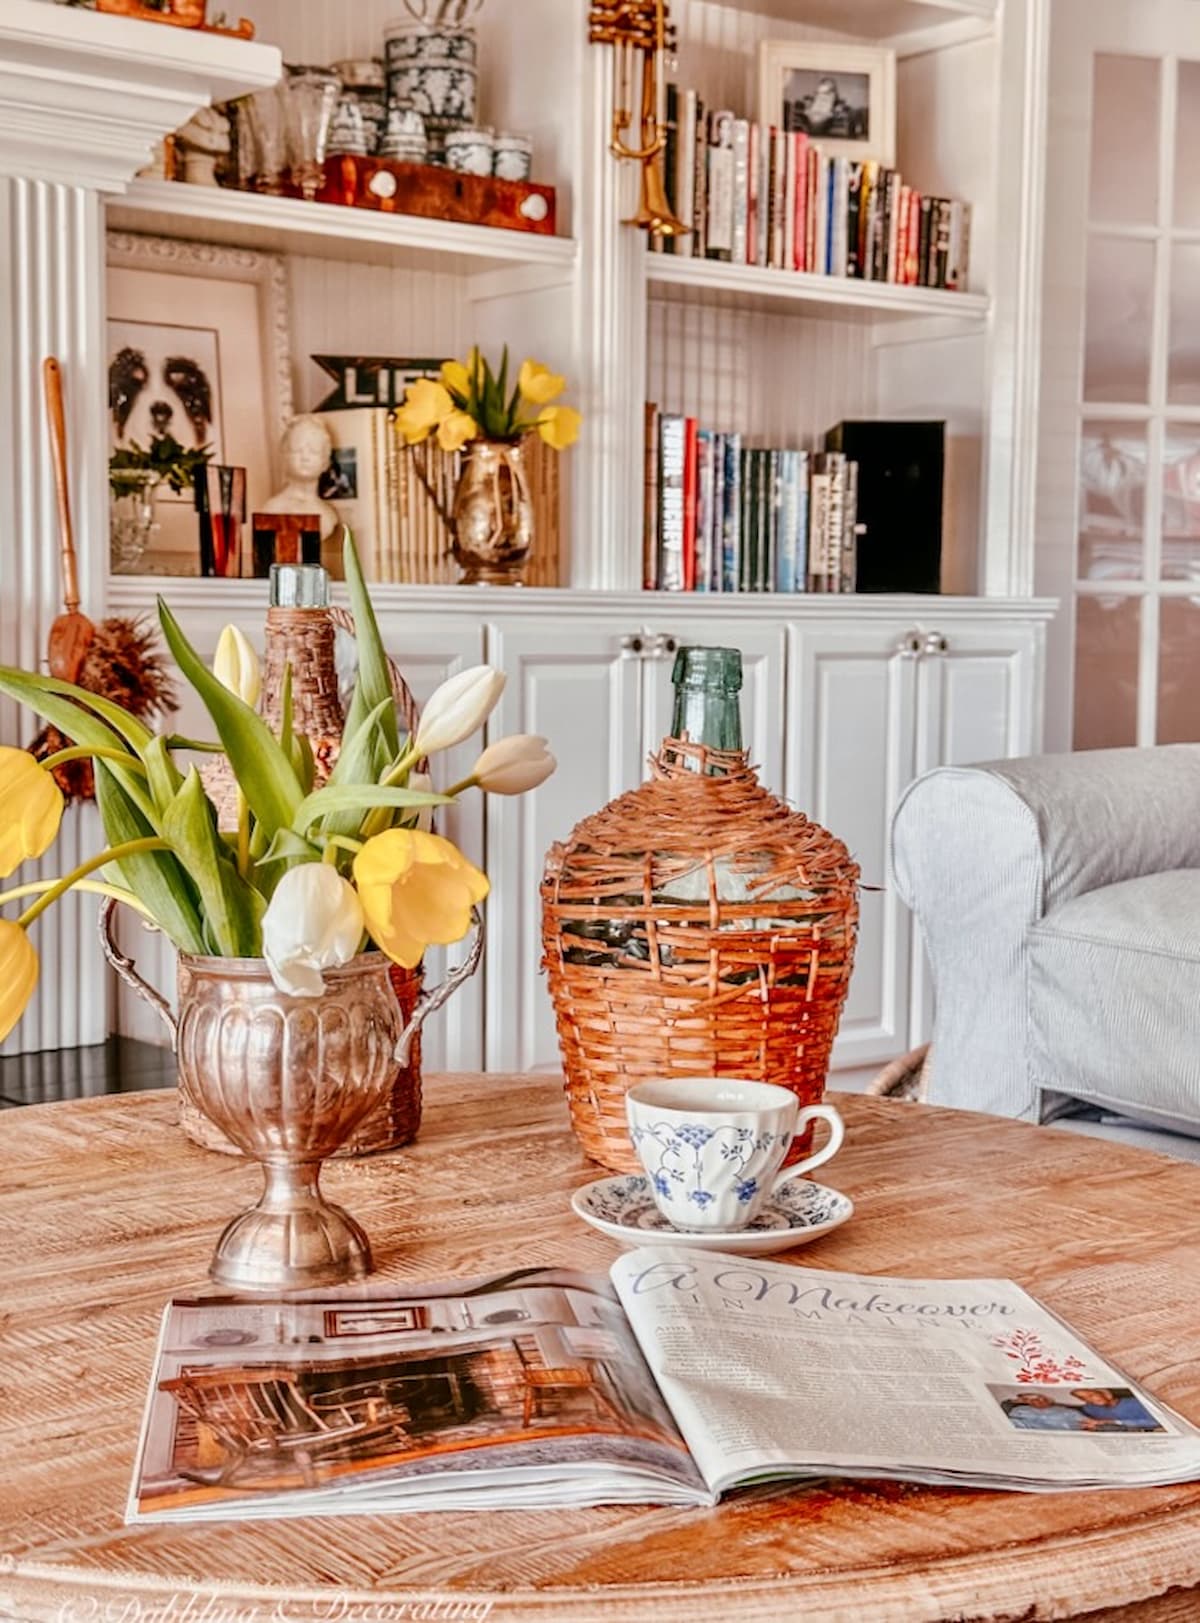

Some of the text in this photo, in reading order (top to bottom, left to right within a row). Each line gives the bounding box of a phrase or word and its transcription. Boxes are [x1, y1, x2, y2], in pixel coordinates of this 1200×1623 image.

[345, 367, 443, 404] LIF
[691, 1293, 745, 1311] IN
[793, 1307, 984, 1330] MAINE
[713, 1270, 1016, 1317] Makeover
